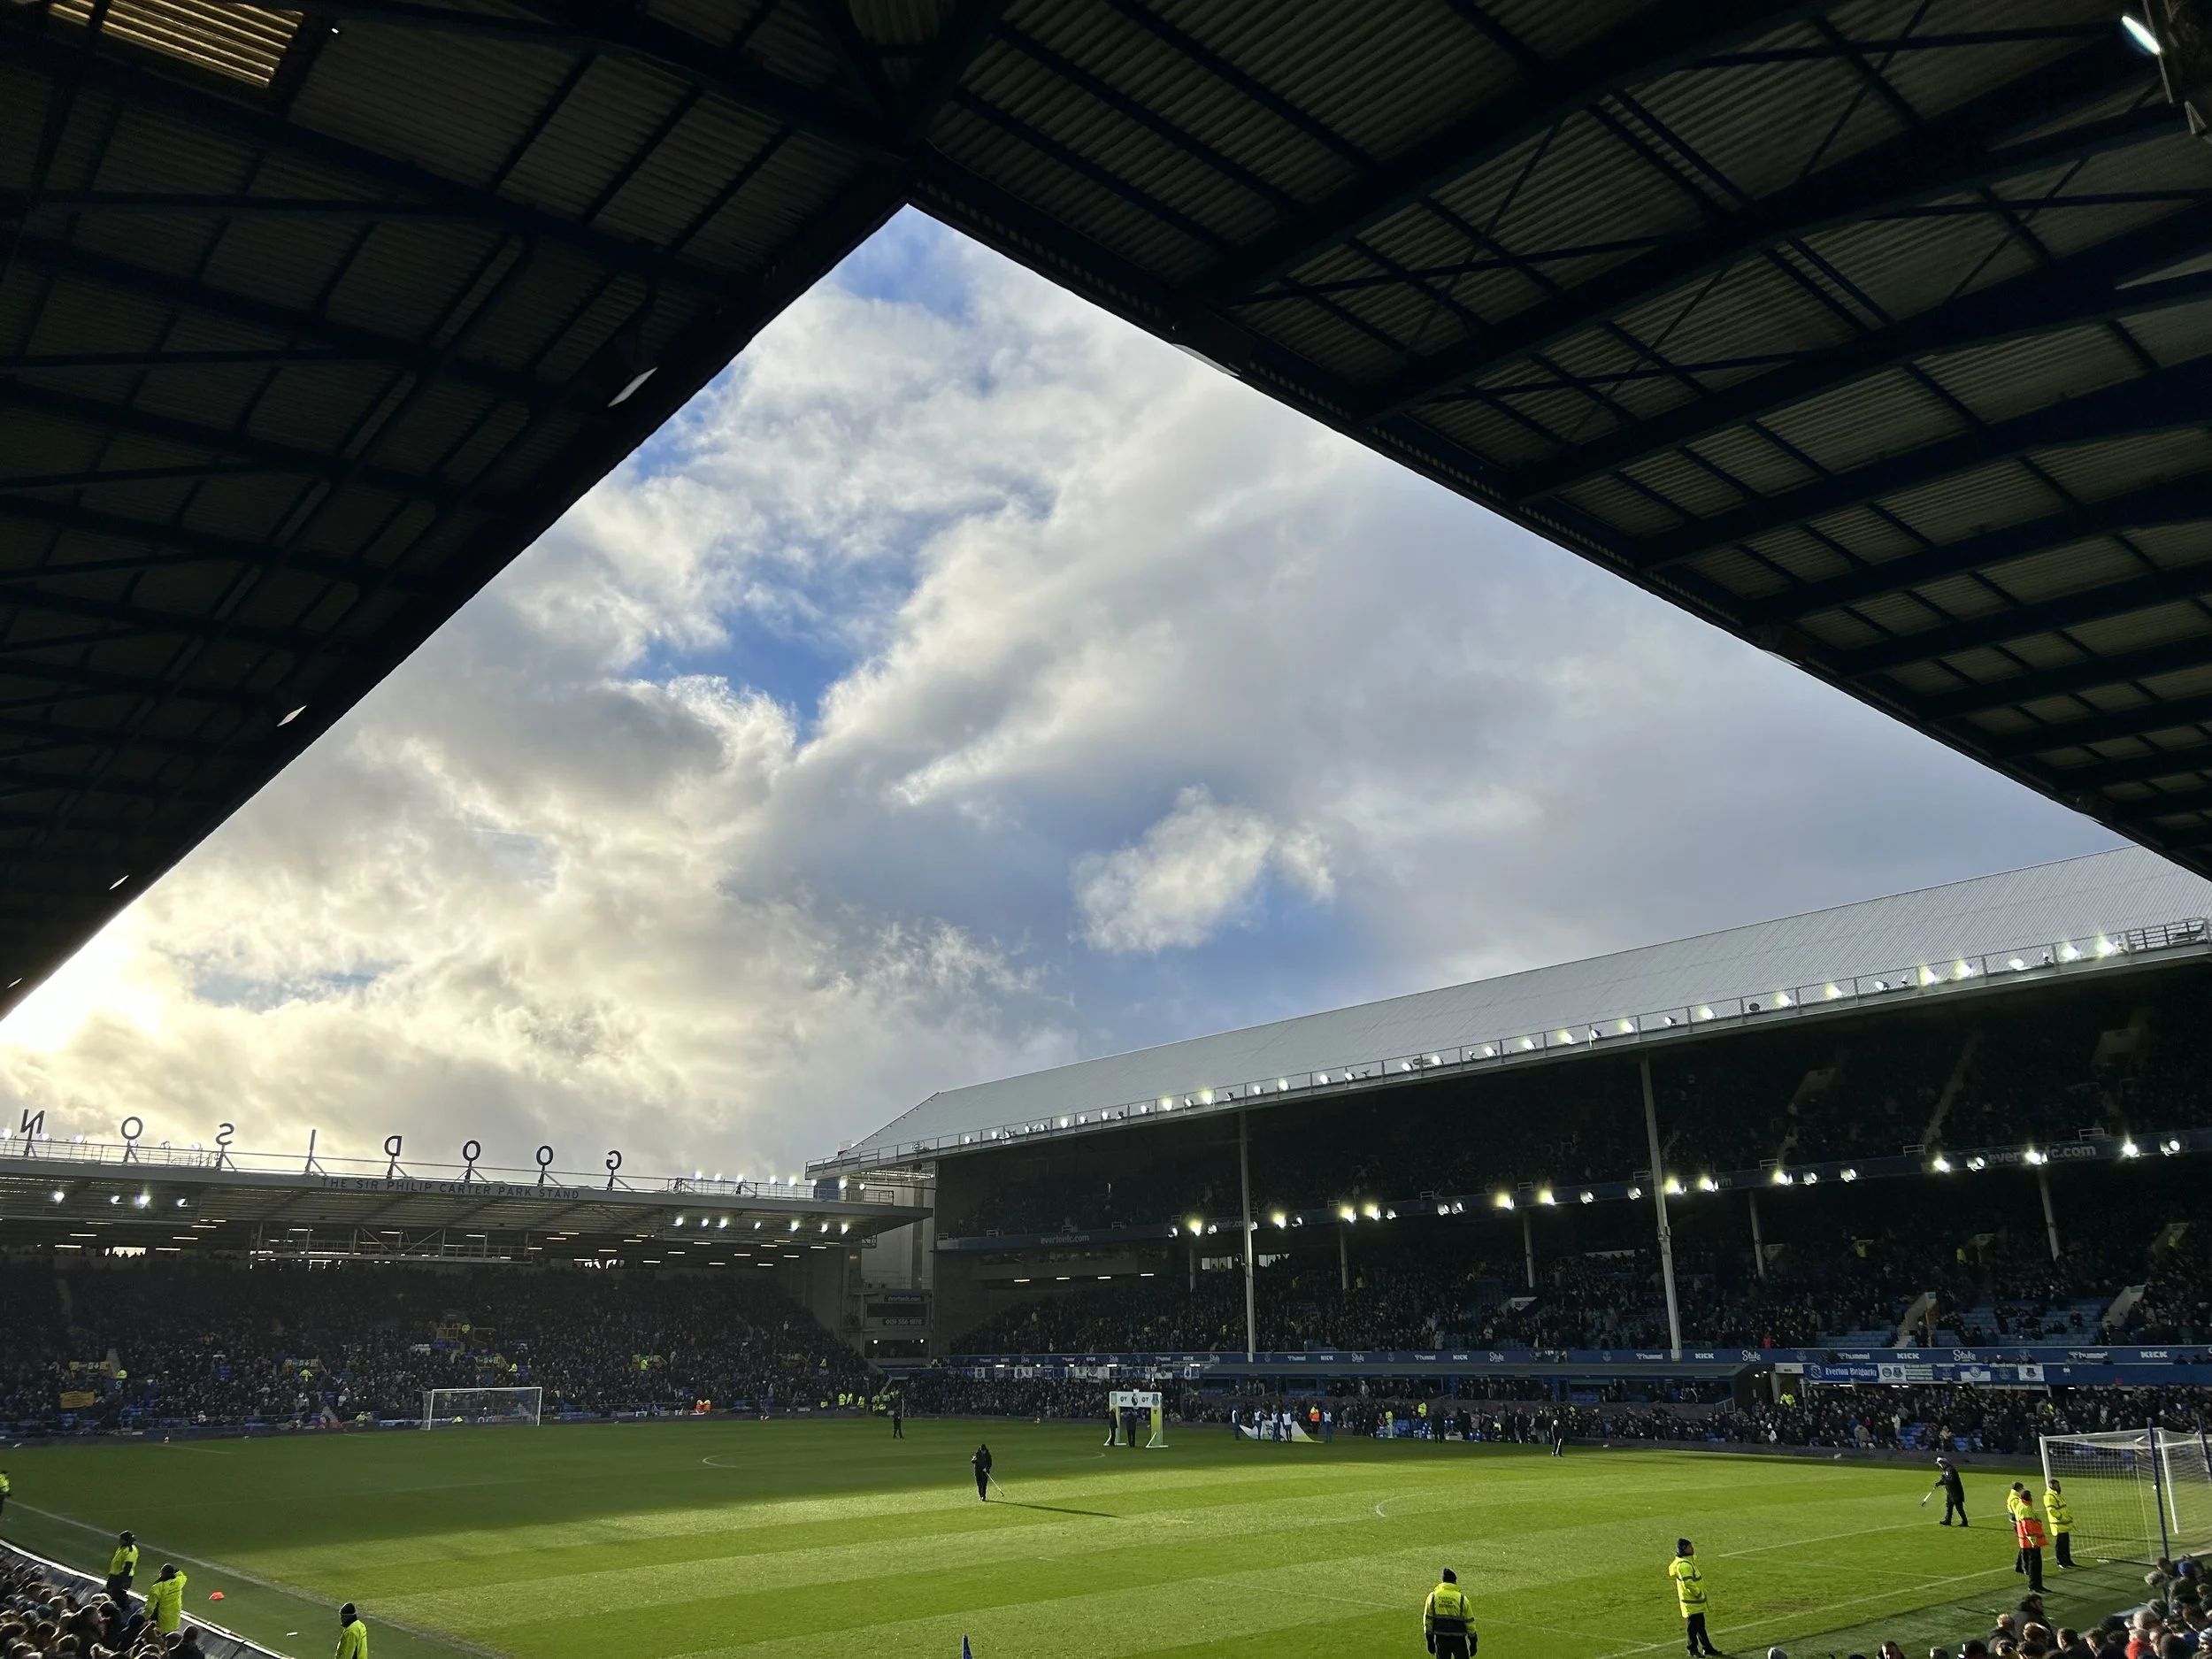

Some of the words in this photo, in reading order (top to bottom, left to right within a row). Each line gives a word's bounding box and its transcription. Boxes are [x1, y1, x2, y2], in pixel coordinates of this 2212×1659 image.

[1987, 1145, 2097, 1164] everfc.com
[321, 1178, 348, 1188] THE
[357, 1179, 378, 1190] SIR
[387, 1181, 432, 1192] PHILIP
[439, 1183, 492, 1194] CARTER
[498, 1186, 532, 1197] PARK
[539, 1188, 580, 1200] STAND
[1953, 1349, 1977, 1361] Stake
[2139, 1350, 2168, 1359] KICK
